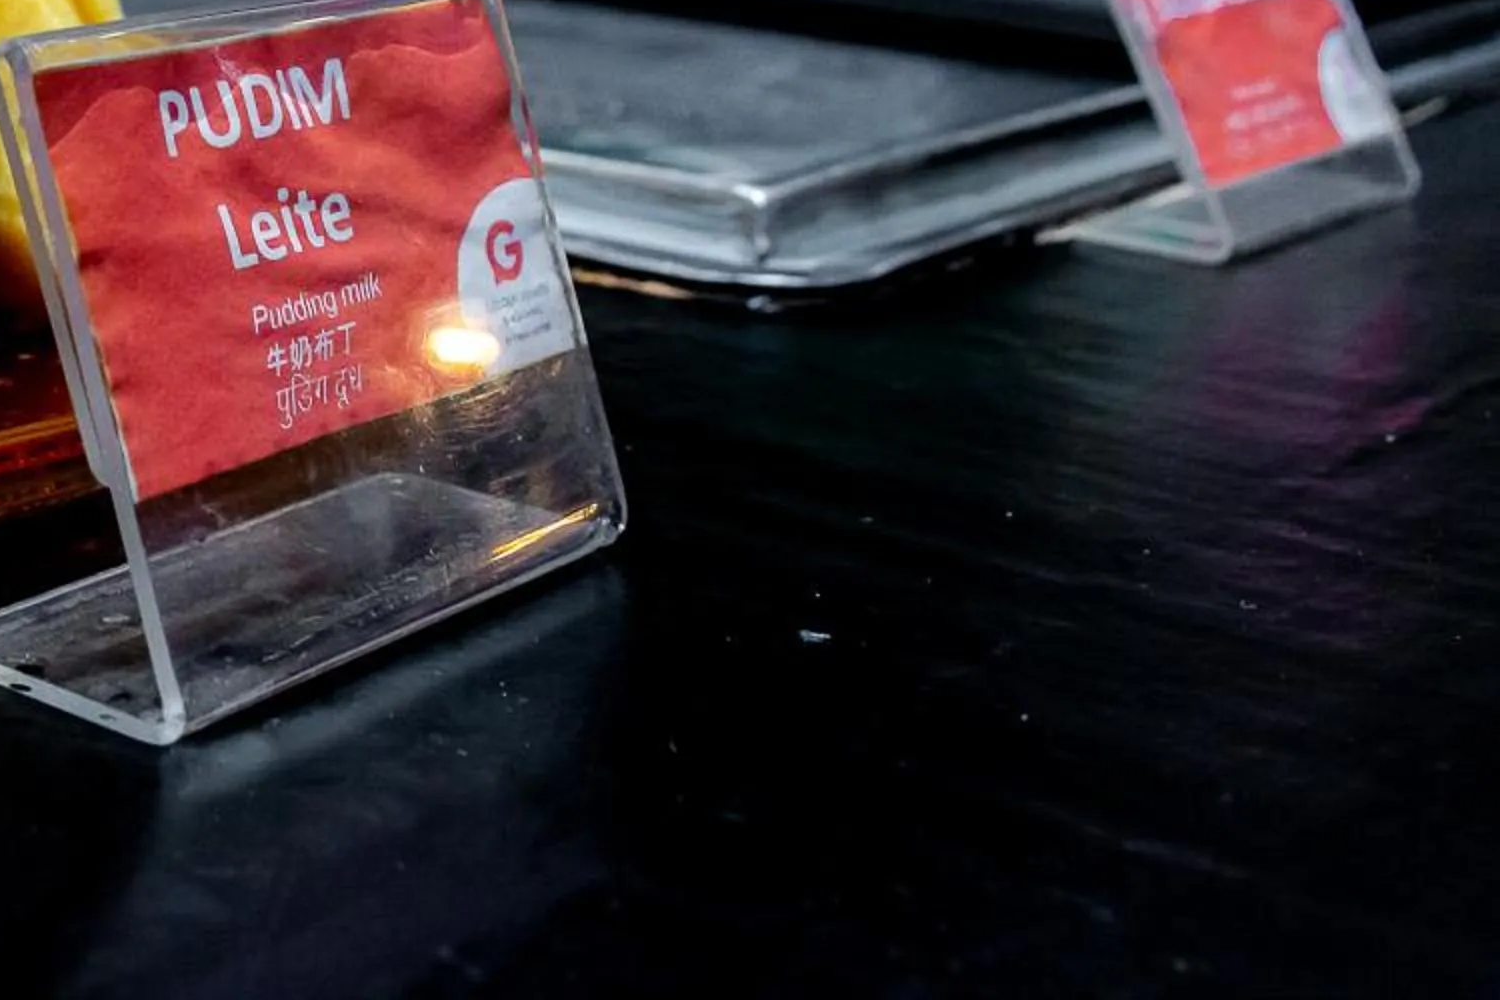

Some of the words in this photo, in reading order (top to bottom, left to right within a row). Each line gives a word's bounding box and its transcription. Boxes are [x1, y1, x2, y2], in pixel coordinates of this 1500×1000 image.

[158, 57, 352, 158] PUDIM
[217, 187, 355, 272] Leite
[252, 291, 338, 335] Pudding
[341, 271, 382, 308] milk
[266, 320, 357, 377] 牛奶布丁
